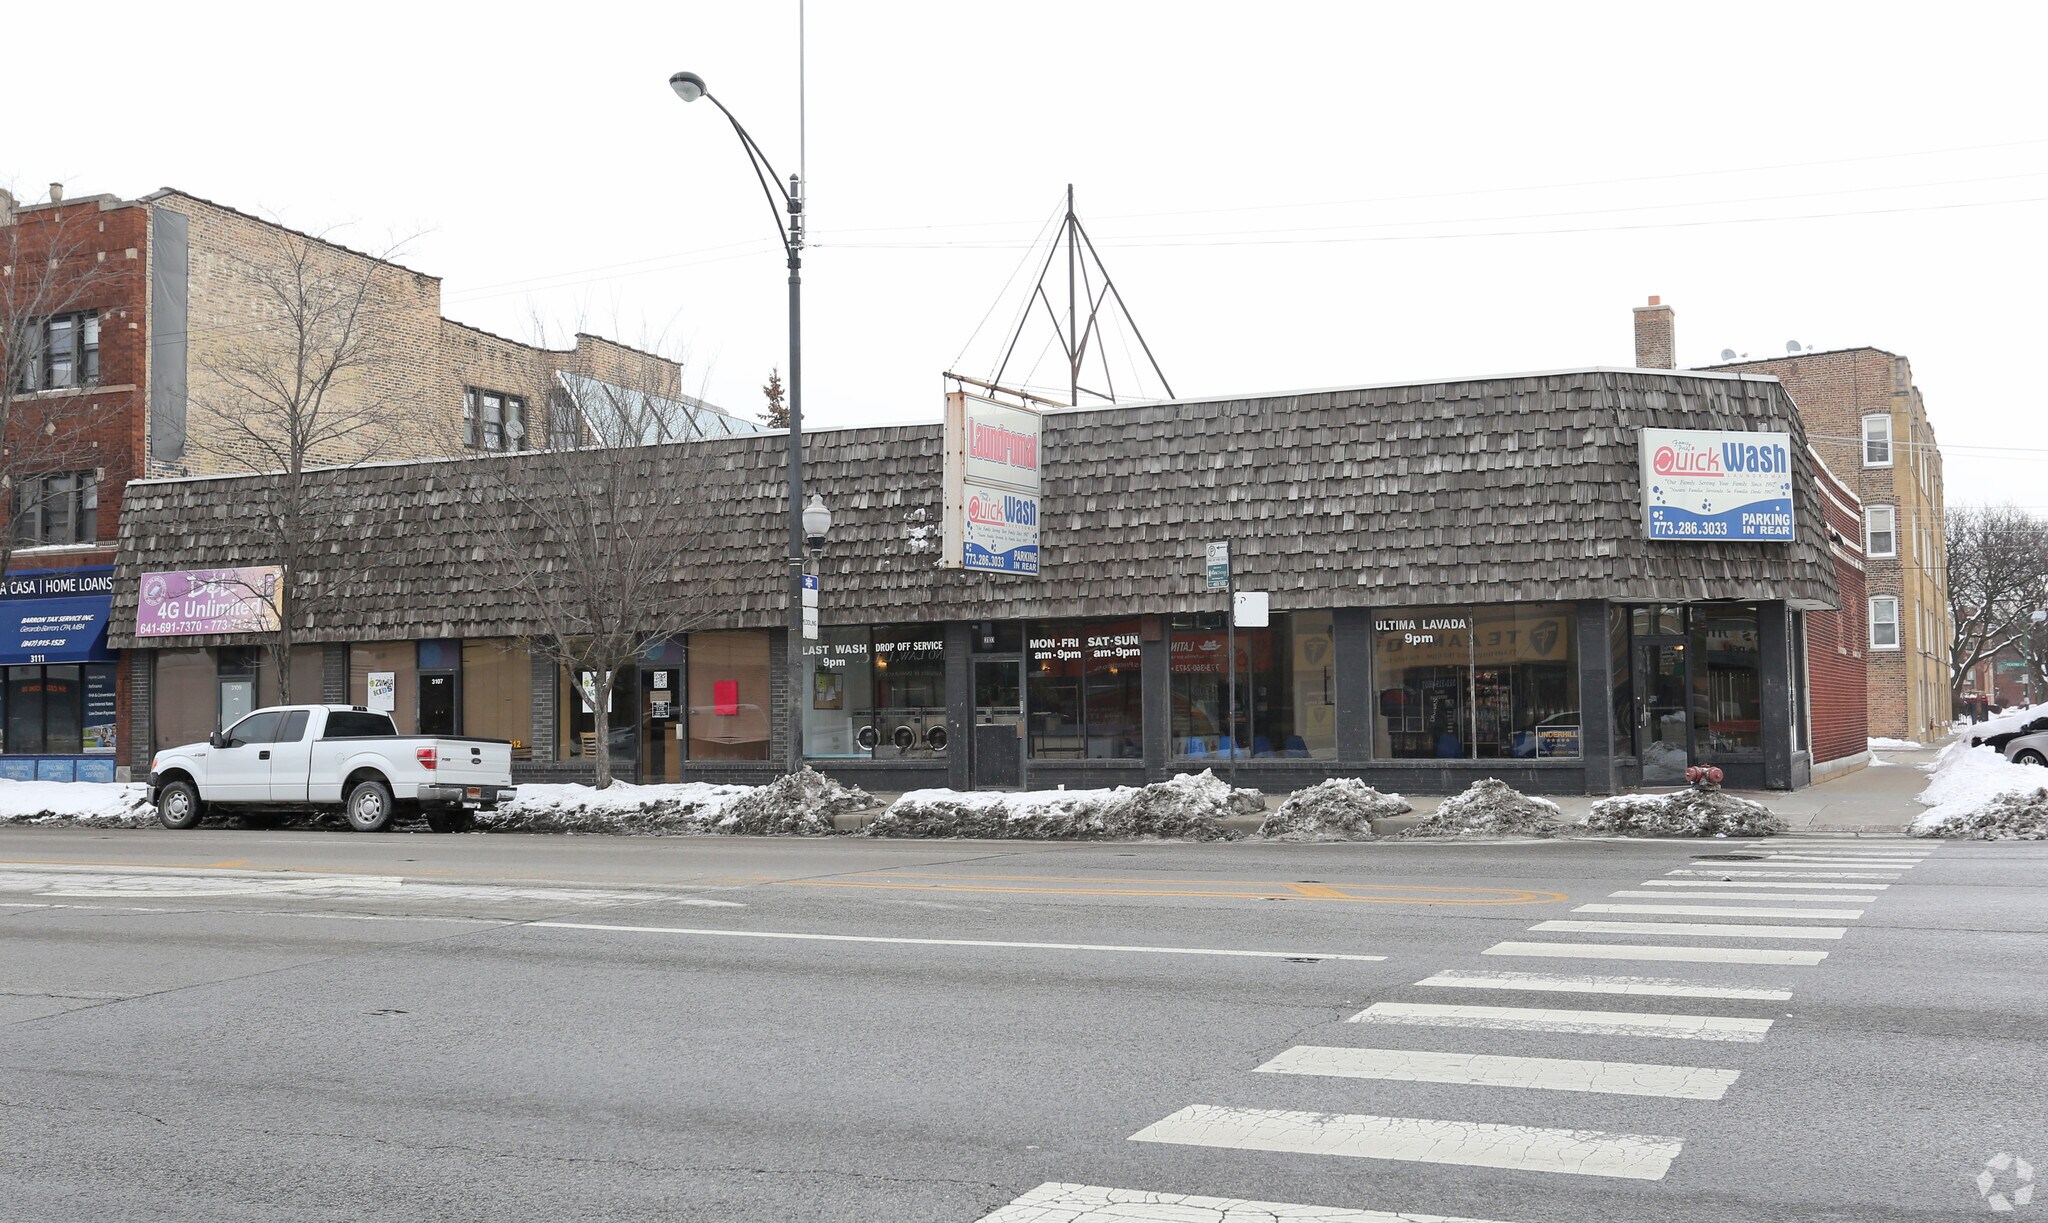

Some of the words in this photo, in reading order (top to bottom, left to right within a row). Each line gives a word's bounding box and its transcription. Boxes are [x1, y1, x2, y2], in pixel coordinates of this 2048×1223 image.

[969, 417, 1036, 471] Laundromat
[1653, 446, 1724, 477] Quick
[1722, 442, 1786, 473] Wash
[968, 496, 1005, 527] Quick
[1004, 495, 1036, 526] Wash
[1742, 513, 1790, 526] PARKING
[1654, 522, 1728, 535] 773.286.3033
[1742, 526, 1755, 534] IN
[1760, 526, 1790, 535] REAR
[965, 553, 1005, 567] 773.286.3033
[1013, 549, 1037, 563] PARKING
[1013, 561, 1020, 570] IN
[1021, 562, 1037, 571] REAR
[10, 580, 36, 595] CASA
[45, 579, 76, 593] HOME
[79, 576, 113, 592] LOANS
[157, 601, 180, 619] 4G
[184, 599, 262, 618] Unlimited
[21, 616, 46, 624] BARRON
[46, 615, 60, 623] TAX
[59, 614, 81, 622] SERVICE
[1375, 620, 1416, 631] ULTIMA
[1422, 618, 1467, 630] LAVADA
[20, 624, 42, 633] Gerardo
[140, 621, 202, 634] 641-691-7370
[875, 642, 895, 652] DROP
[897, 642, 911, 651] OFF
[913, 640, 943, 650] SERVICE
[1404, 633, 1434, 646] 9pm
[802, 645, 829, 655] LAST
[835, 644, 867, 654] WASH
[30, 654, 45, 663] 3111
[822, 657, 846, 668] 9pm
[373, 686, 393, 697] KIDS
